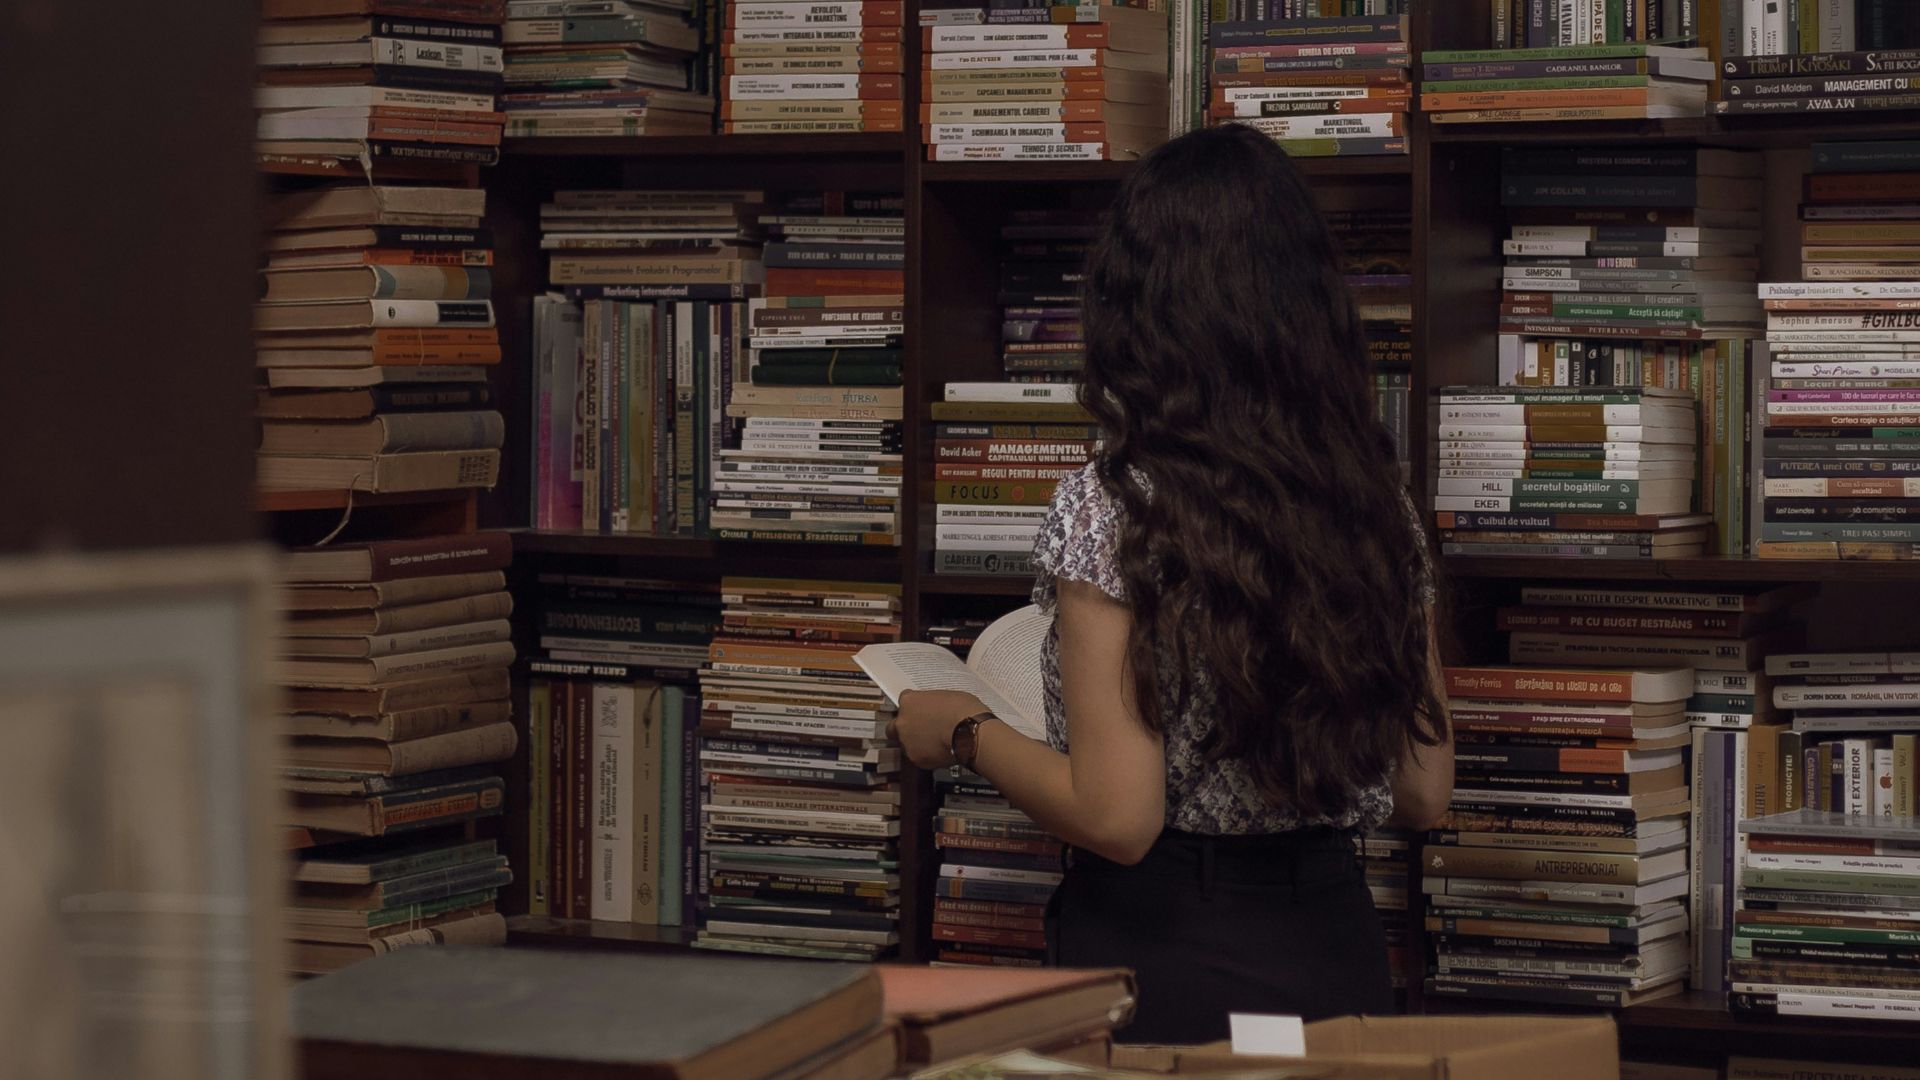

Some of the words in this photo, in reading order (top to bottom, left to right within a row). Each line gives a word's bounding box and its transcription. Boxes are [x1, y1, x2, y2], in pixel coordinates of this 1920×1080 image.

[1728, 28, 1736, 53] KLEIN
[416, 48, 442, 61] Lexicon
[1322, 47, 1331, 55] DE
[1331, 46, 1356, 55] SUCCES
[1545, 65, 1588, 74] CADRANUL
[1589, 63, 1622, 72] BANILOR
[1748, 60, 1788, 74] TRUMP
[1797, 58, 1851, 72] KIYOSAKI
[1755, 84, 1779, 95] David
[1780, 83, 1813, 93] Molden
[1824, 79, 1894, 92] MANAGEMENT
[1894, 78, 1908, 89] CU
[1806, 99, 1833, 110] WAY
[1834, 98, 1856, 109] MY
[972, 109, 1022, 117] MANAGEMENTUL
[1023, 108, 1050, 116] CARIEREI
[1323, 119, 1363, 127] MARKETINGUL
[971, 128, 1008, 137] SCHIMBAREA
[1314, 127, 1335, 135] DIRECT
[1336, 126, 1371, 135] MULTICANAL
[1021, 145, 1045, 153] TEHNICI
[1054, 145, 1082, 153] SECRETE
[579, 265, 634, 275] Fundamentele
[672, 265, 722, 276] Programelor
[1525, 268, 1562, 277] SIMPSON
[603, 286, 640, 299] Marketing
[641, 285, 688, 297] international
[1768, 286, 1806, 296] Psihologia
[1780, 316, 1811, 326] Sophia
[1814, 317, 1853, 325] Amoruso
[1804, 380, 1836, 389] Locuri
[1839, 380, 1852, 388] de
[1854, 380, 1888, 389] muncă
[1022, 388, 1051, 397] AFACERI
[1841, 391, 1852, 399] 100
[1852, 391, 1860, 399] de
[1860, 391, 1878, 399] lucruri
[1879, 393, 1886, 401] pe
[841, 394, 879, 404] BURSA
[1524, 394, 1540, 403] noul
[1541, 394, 1574, 404] manager
[1575, 394, 1582, 402] la
[1583, 394, 1605, 402] minut
[839, 409, 876, 418] BURSA
[1831, 416, 1859, 425] Cartea
[940, 446, 960, 458] David
[988, 444, 1087, 455] MANAGEMENTUL
[988, 454, 1037, 462] CAPITALULUI
[1060, 455, 1088, 463] BRAND
[1780, 462, 1820, 471] PUTEREA
[1844, 462, 1864, 471] ORE
[1892, 462, 1910, 471] DAVE
[981, 469, 1007, 478] REGULI
[1008, 469, 1036, 479] PENTRU
[950, 485, 999, 499] FOCUS
[1482, 482, 1503, 492] HILL
[1522, 481, 1561, 492] secretul
[1563, 481, 1611, 493] bogățiilor
[1474, 499, 1500, 509] EKER
[1519, 501, 1546, 509] secretele
[1567, 501, 1575, 509] de
[1576, 501, 1603, 509] milionar
[1862, 506, 1895, 515] comunici
[1477, 517, 1506, 526] Cuibul
[1507, 517, 1517, 526] de
[1518, 517, 1550, 526] vulturi
[720, 530, 748, 540] OHMAE
[1841, 530, 1860, 538] TREI
[1575, 594, 1611, 604] KOTLER
[1614, 595, 1649, 605] DESPRE
[1653, 595, 1711, 607] MARKETING
[545, 611, 642, 632] ECOTEHNOLOGIE
[1569, 616, 1584, 626] PR
[1585, 617, 1601, 627] CU
[1602, 617, 1638, 628] BUGET
[1454, 676, 1479, 690] Timothy
[1479, 677, 1502, 688] Ferriss
[1803, 693, 1824, 701] DORIN
[1883, 693, 1895, 701] UN
[812, 708, 819, 717] la
[819, 708, 840, 717] succes
[1851, 747, 1860, 801] EXTERIOR
[1784, 753, 1794, 809] PRODUCȚIEI
[1534, 859, 1620, 877] ANTREPRENORIAT
